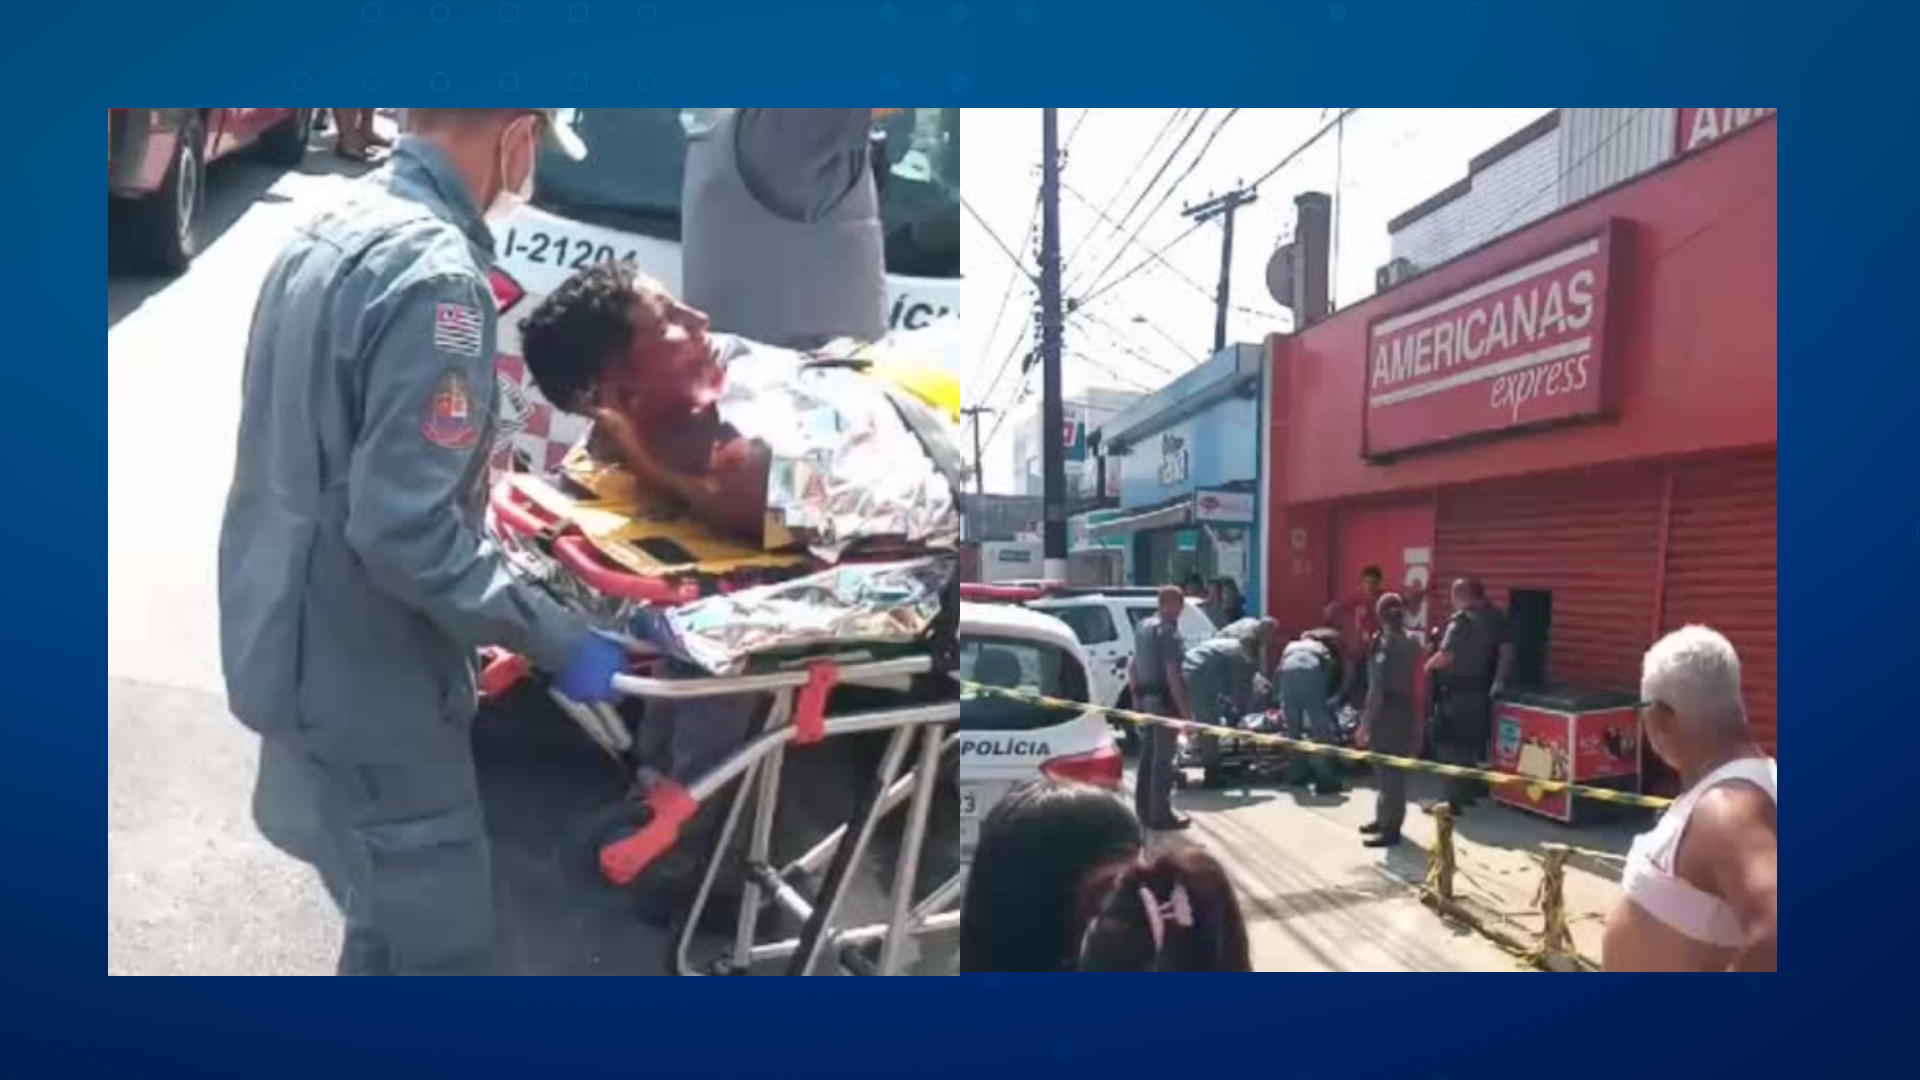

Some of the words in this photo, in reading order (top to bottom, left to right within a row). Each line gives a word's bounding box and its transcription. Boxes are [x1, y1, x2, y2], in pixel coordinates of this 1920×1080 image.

[1373, 269, 1594, 389] AMERICANAS
[1490, 354, 1590, 420] express
[960, 737, 1050, 756] POLÍCIA
